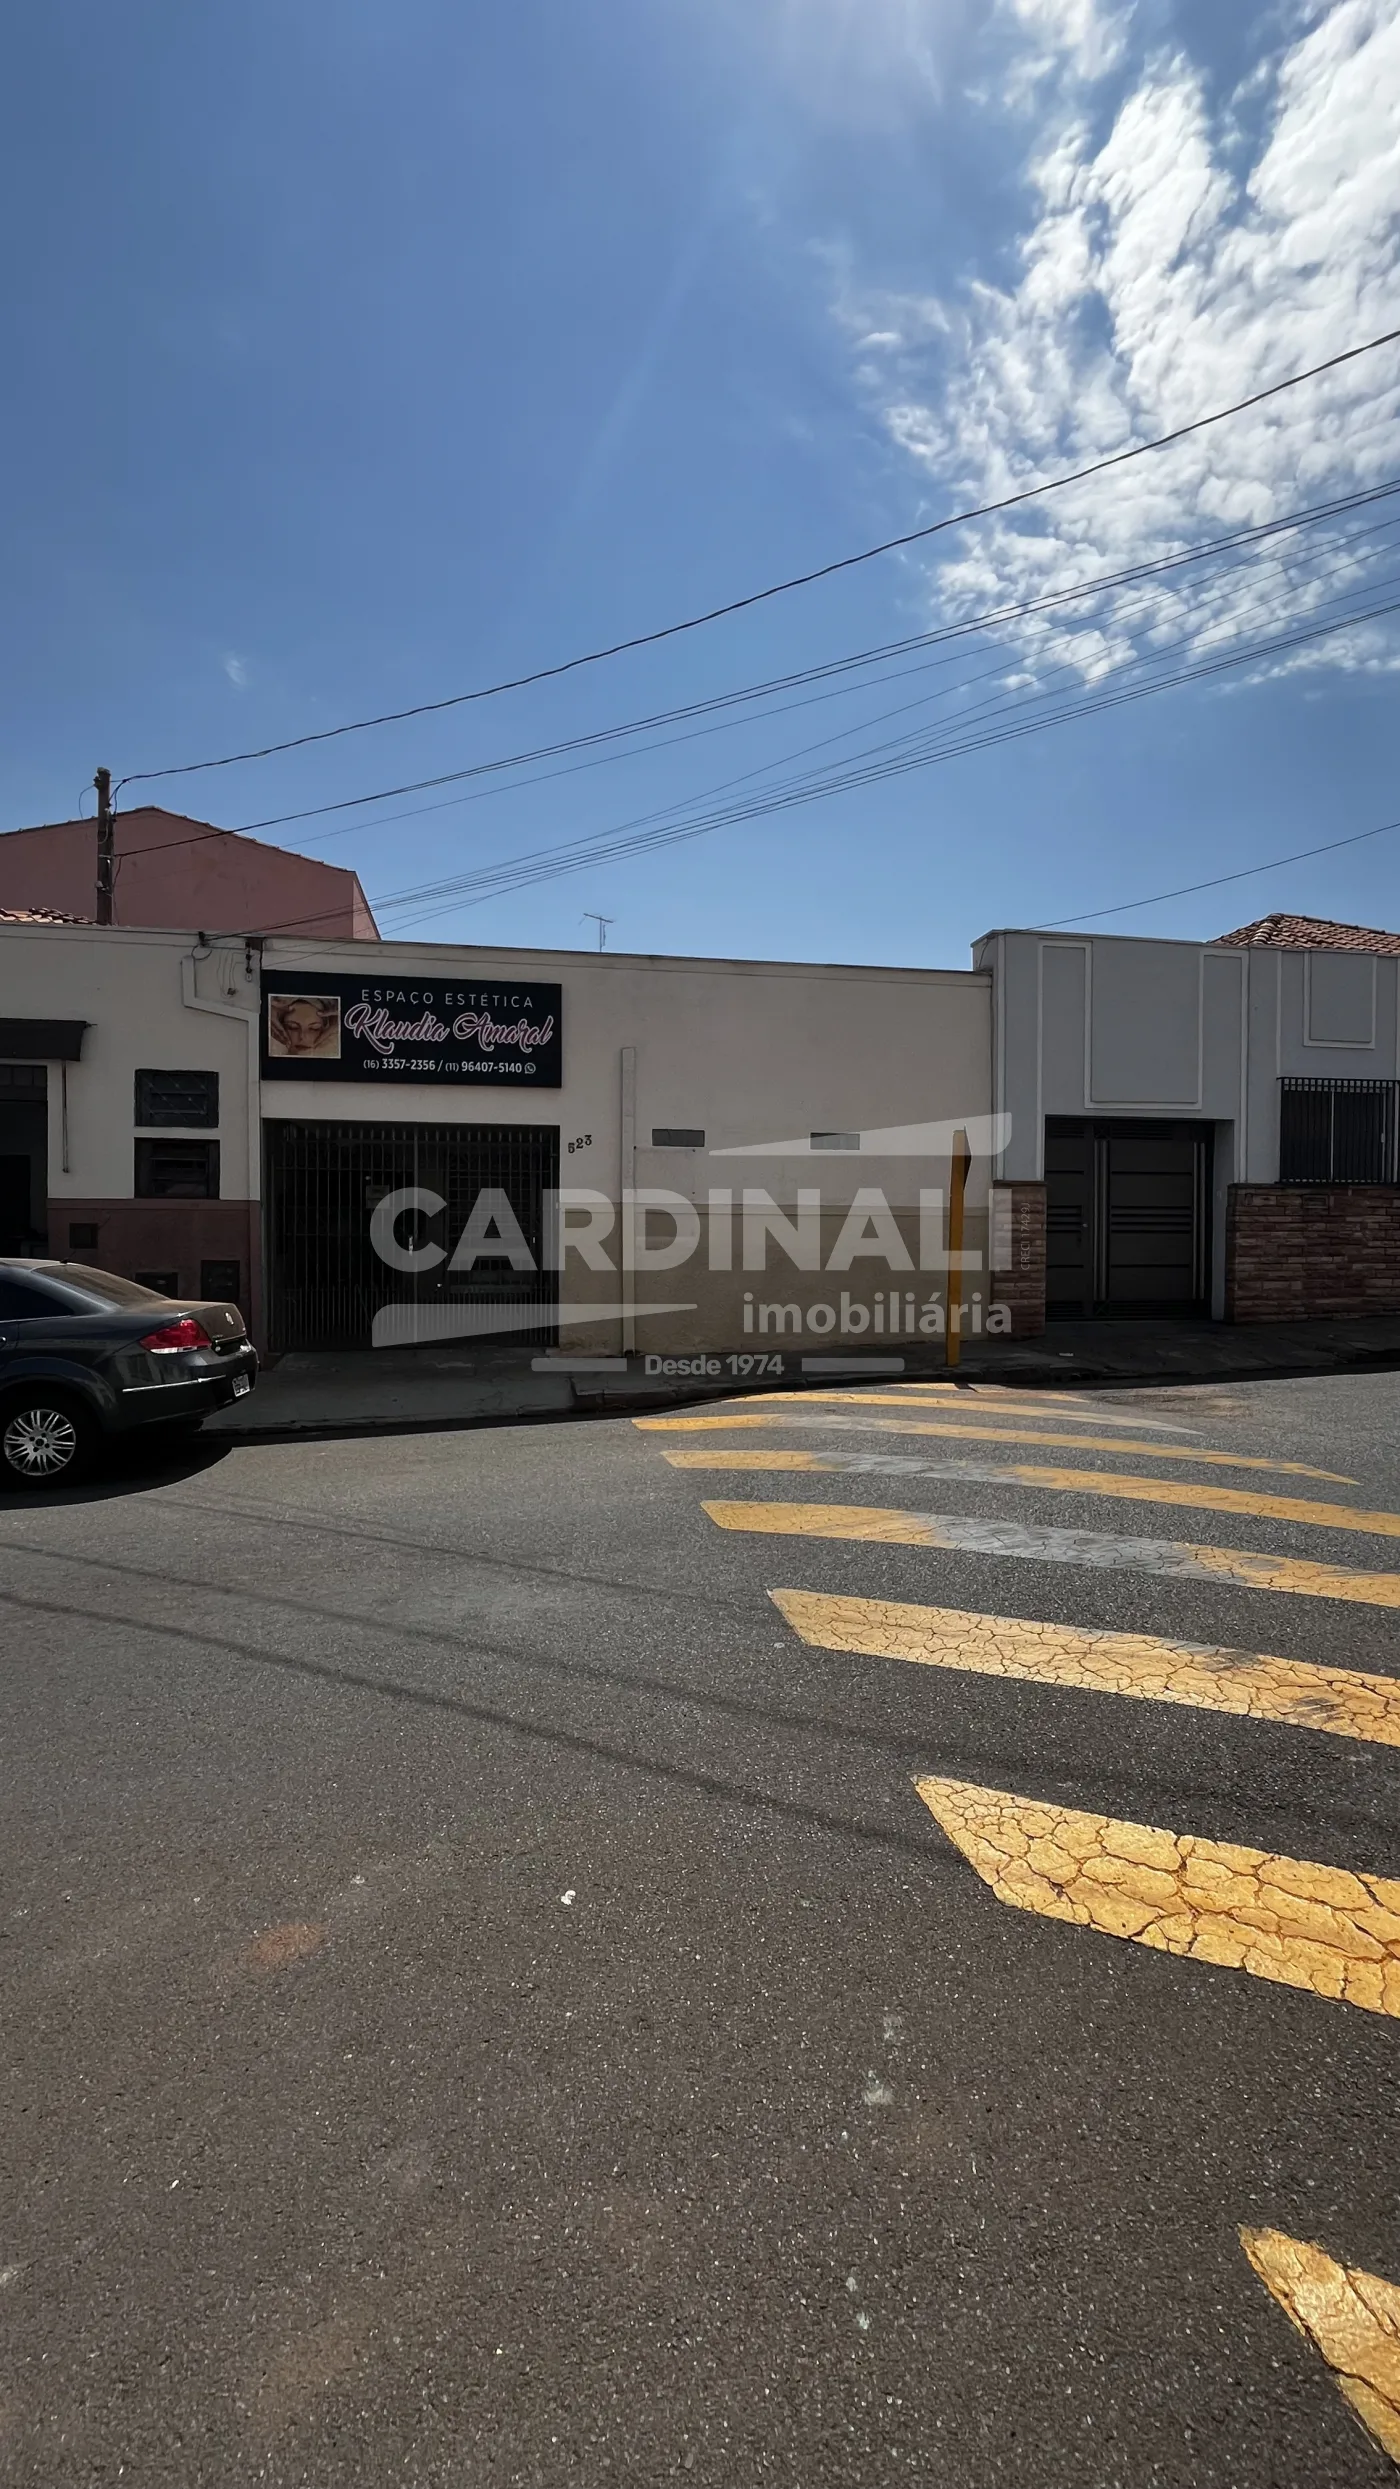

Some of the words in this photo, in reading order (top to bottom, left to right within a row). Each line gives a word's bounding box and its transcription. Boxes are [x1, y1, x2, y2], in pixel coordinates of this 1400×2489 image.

[361, 989, 434, 1005] ESPAÇO
[445, 992, 533, 1008] ESTÉTICA
[344, 1003, 450, 1055] Klaudia
[452, 1012, 554, 1053] Amaral
[363, 1059, 380, 1070] (16)
[381, 1058, 436, 1071] 3357-2356
[445, 1062, 459, 1073] (11)
[461, 1061, 522, 1073] 96407-5140
[567, 1134, 593, 1154] 523
